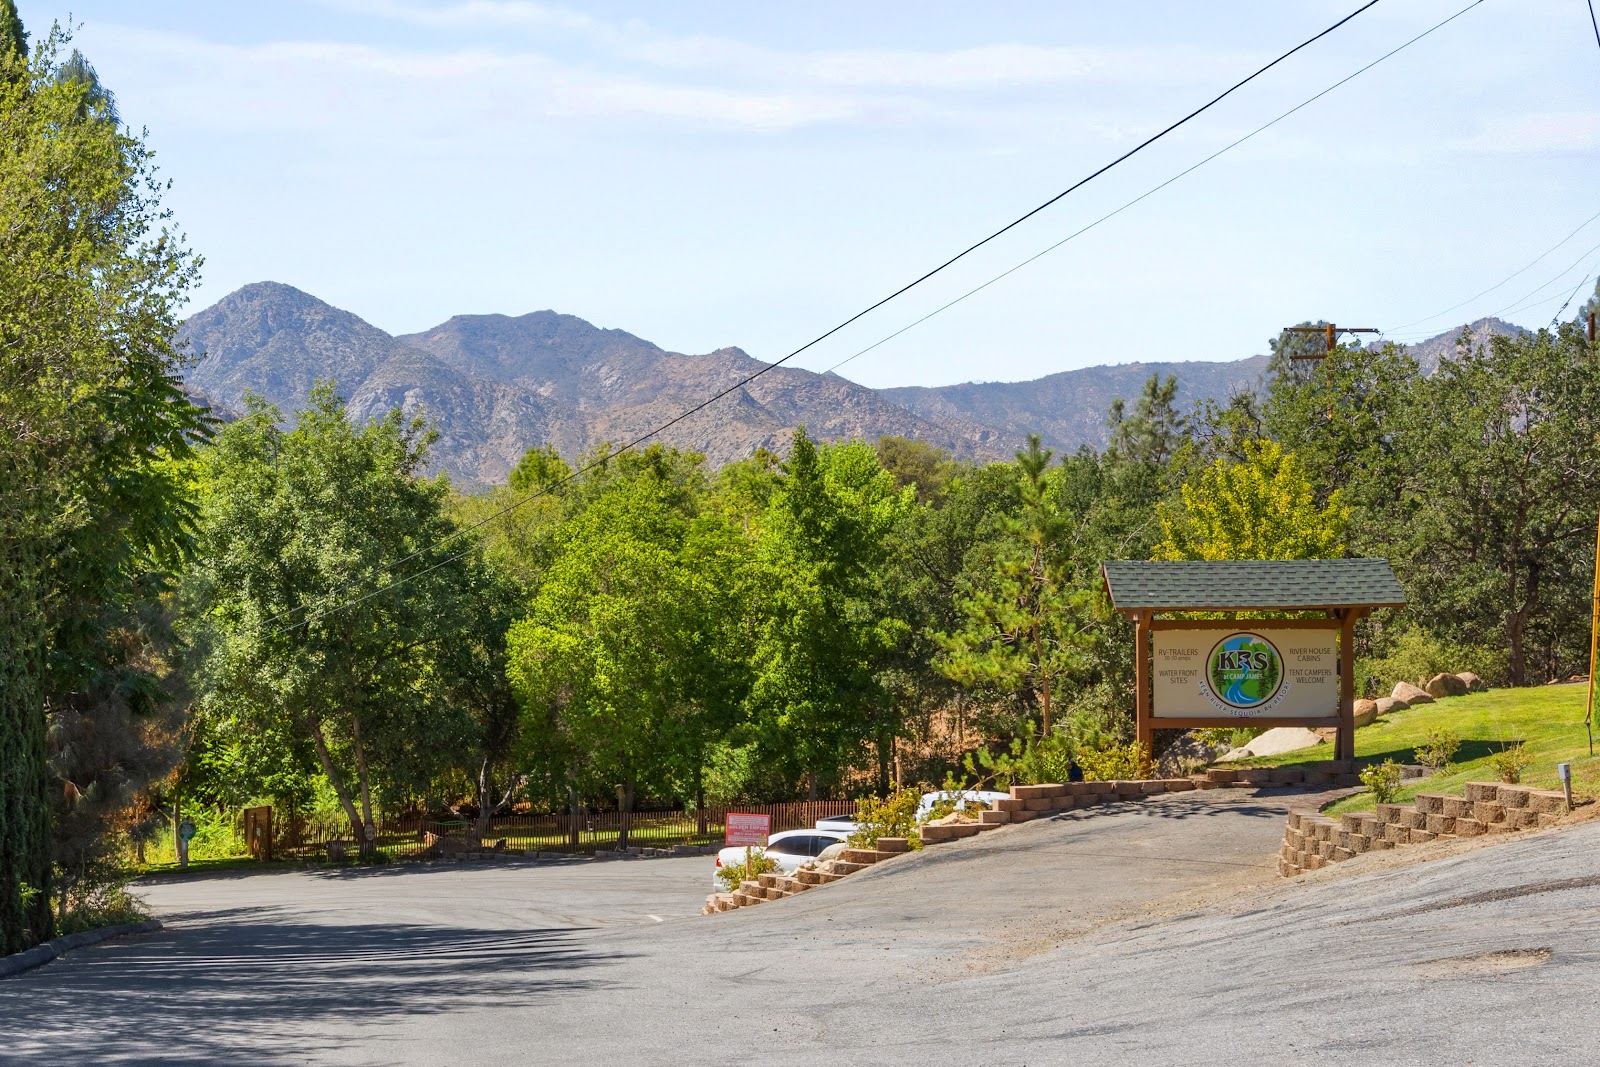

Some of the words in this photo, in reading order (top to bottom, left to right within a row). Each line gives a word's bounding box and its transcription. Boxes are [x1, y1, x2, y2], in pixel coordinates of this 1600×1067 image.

[1218, 651, 1269, 670] KRS
[1199, 681, 1210, 697] KERN
[1210, 698, 1227, 711] RIVER
[1230, 709, 1261, 717] SEQUOIA
[1274, 682, 1291, 704] RESORT
